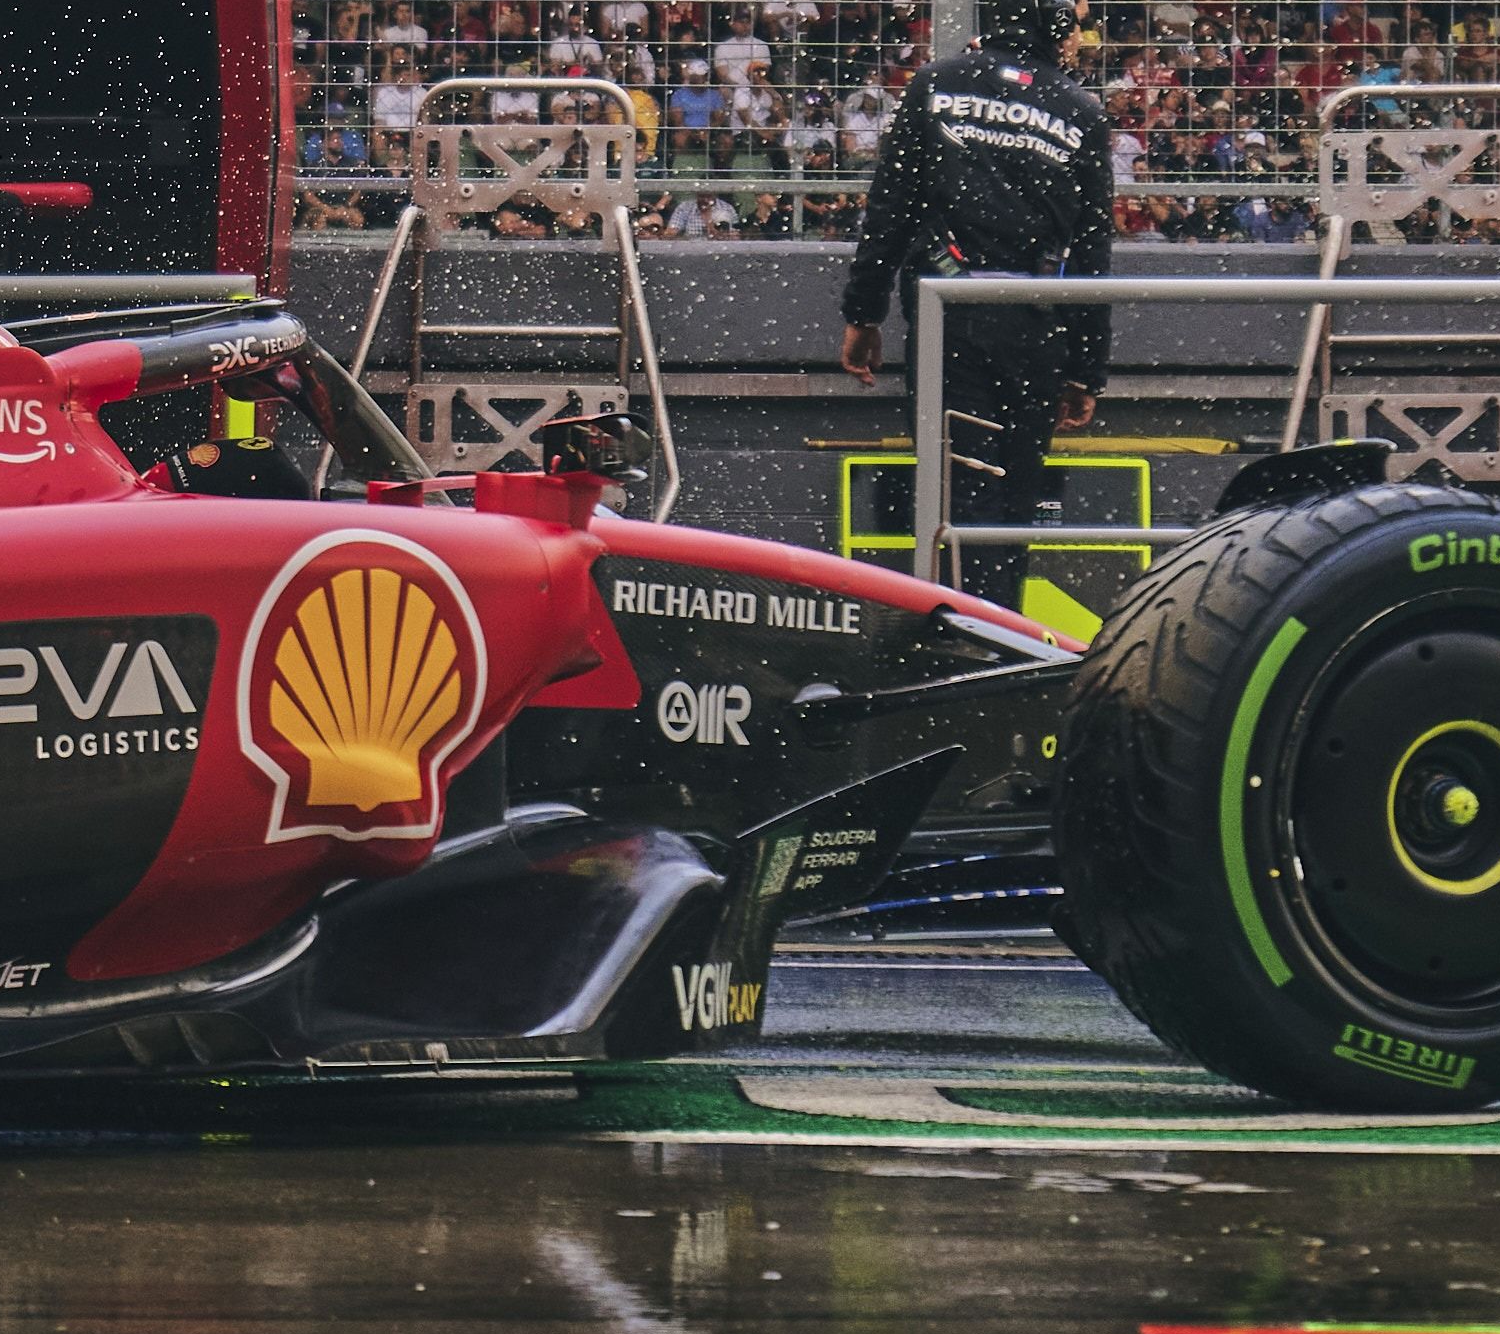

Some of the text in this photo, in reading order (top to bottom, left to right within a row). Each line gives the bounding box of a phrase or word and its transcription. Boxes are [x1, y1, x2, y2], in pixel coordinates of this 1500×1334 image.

[932, 94, 1085, 149] PETRONAS
[951, 124, 1071, 164] CROWDSTRIKE
[209, 336, 260, 372] DXC
[613, 580, 862, 635] RICHARD MILLE
[36, 726, 200, 759] LOGISTICS
[810, 829, 877, 847] SCUDERIA
[793, 874, 823, 890] APP
[1333, 1024, 1476, 1089] PIRELLI
